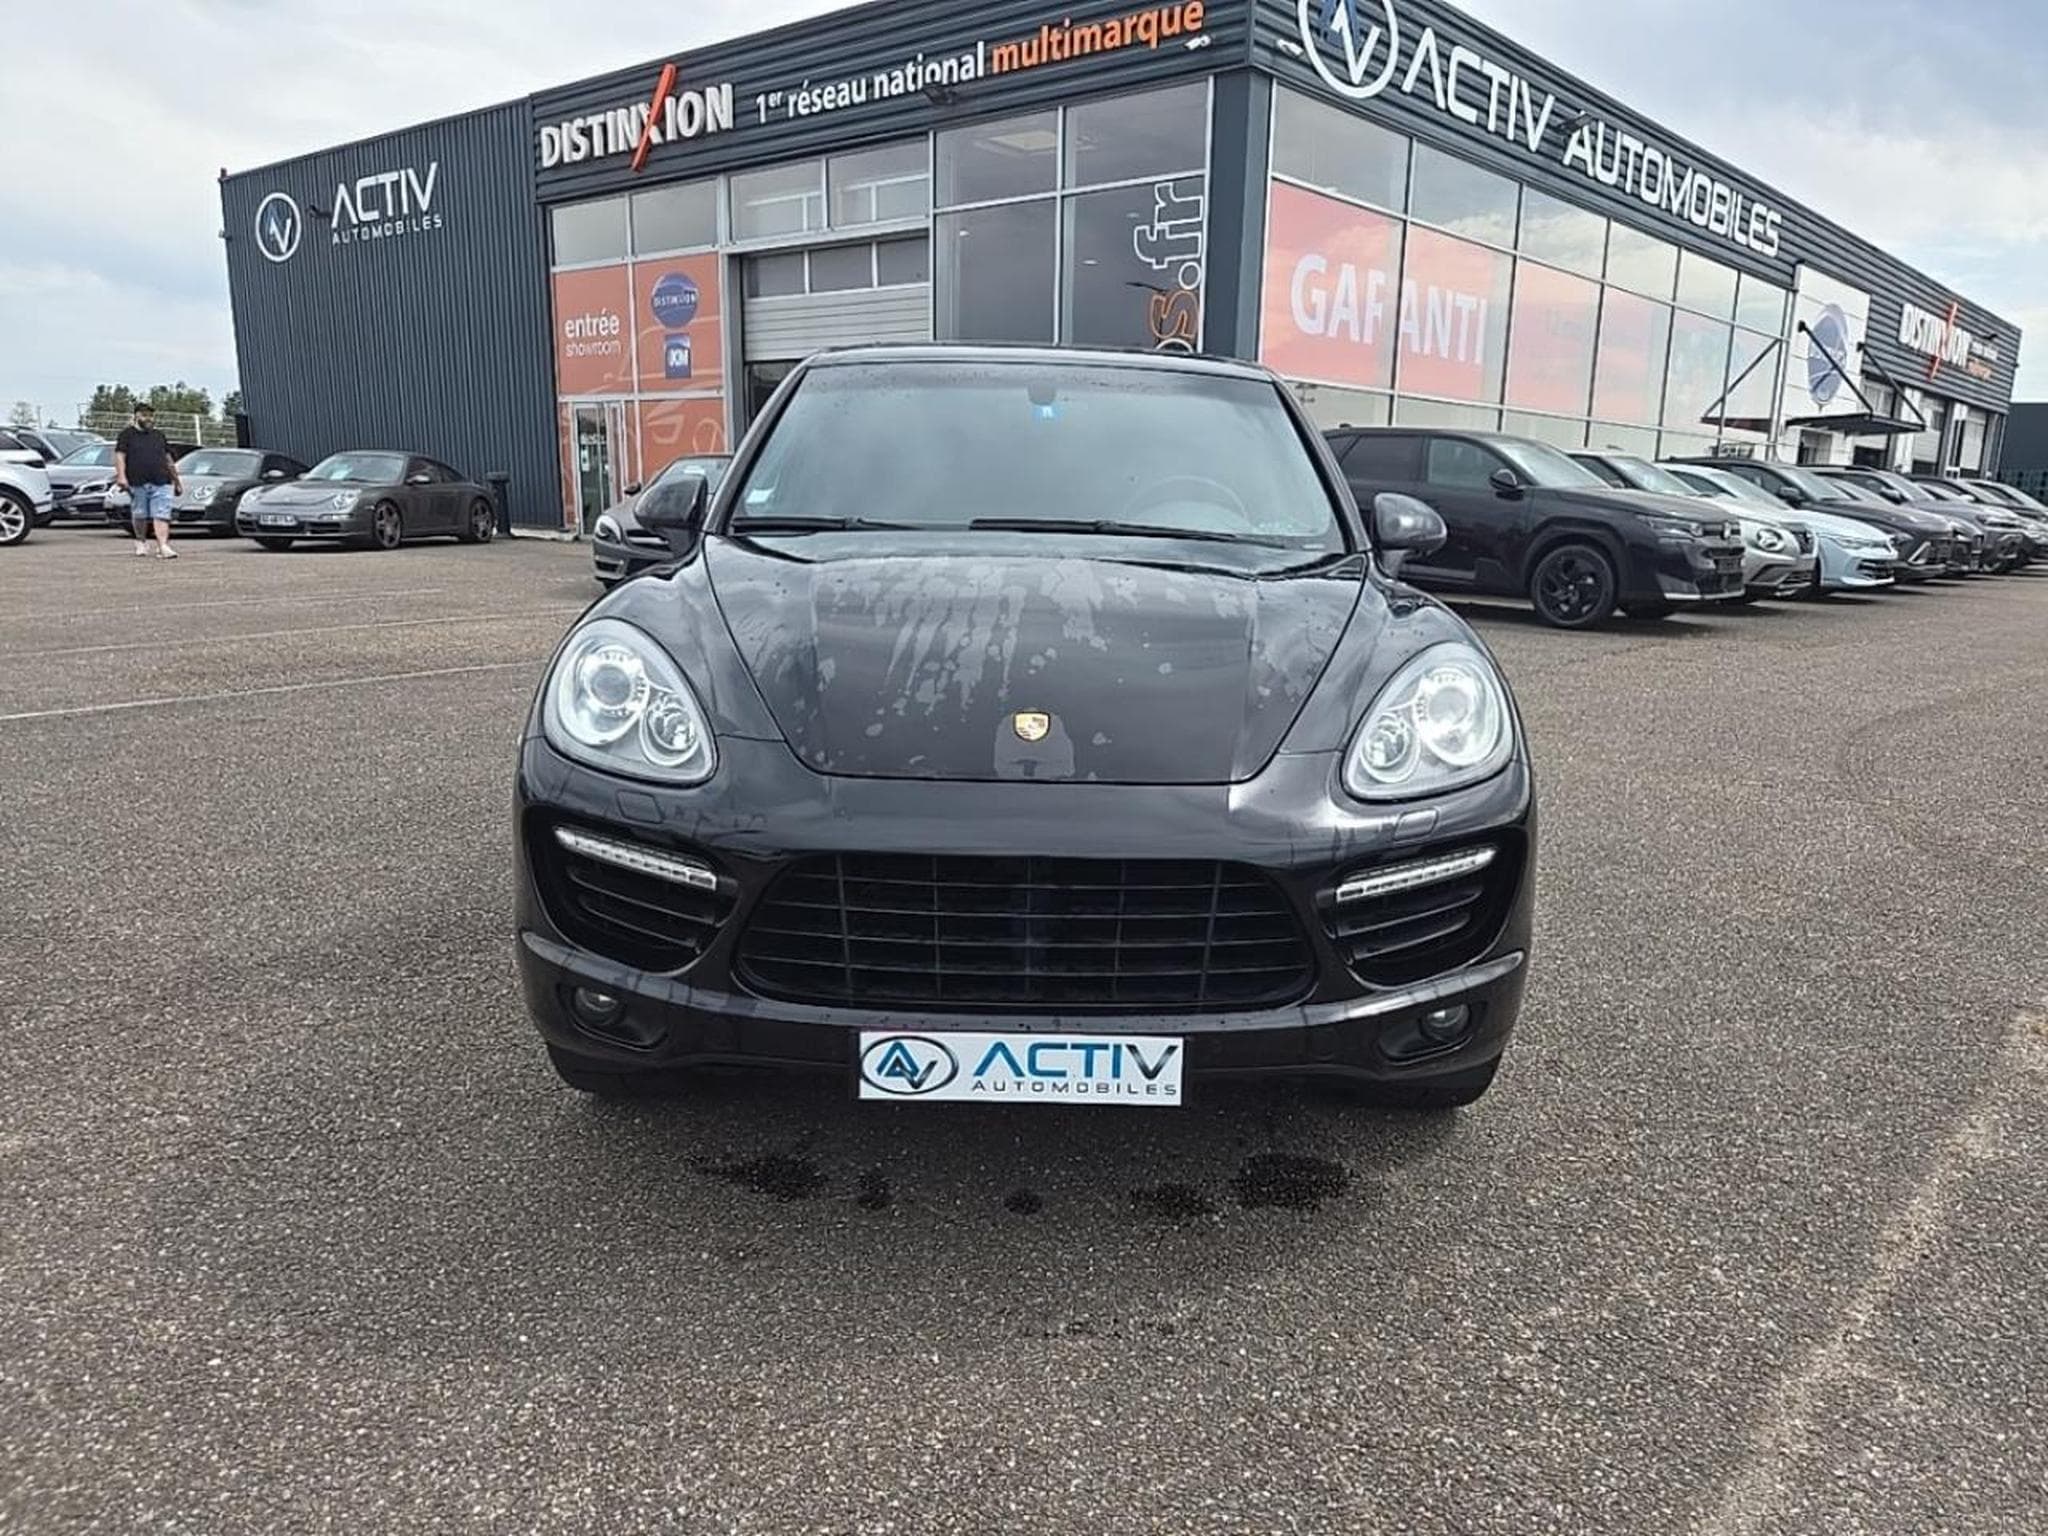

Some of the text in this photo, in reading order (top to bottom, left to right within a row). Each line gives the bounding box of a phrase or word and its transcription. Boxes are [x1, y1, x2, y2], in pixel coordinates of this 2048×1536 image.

[756, 1, 1205, 124] 1er réseau national multimarque
[541, 63, 735, 173] DISTINXION
[1401, 27, 1782, 258] ACTIV AUTOMOBILES
[331, 161, 438, 229] ACTIV
[332, 213, 443, 246] AUTOMOBILES
[564, 307, 620, 338] entrée
[565, 339, 622, 358] showroom
[973, 1042, 1178, 1080] ACTIV
[972, 1080, 1177, 1096] AUTOMOBILES
